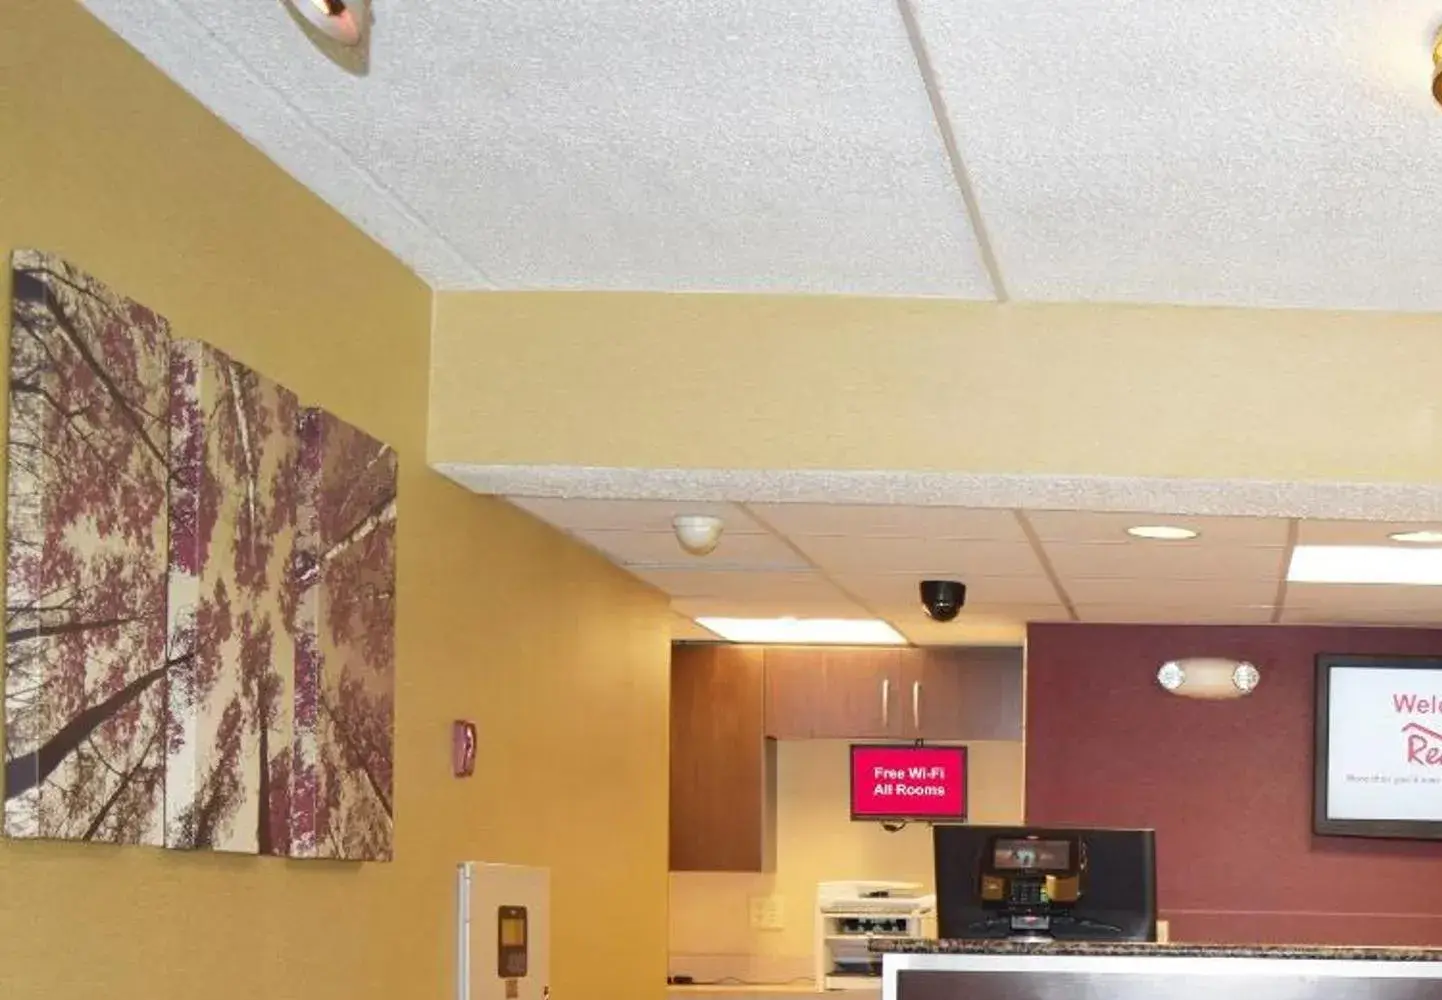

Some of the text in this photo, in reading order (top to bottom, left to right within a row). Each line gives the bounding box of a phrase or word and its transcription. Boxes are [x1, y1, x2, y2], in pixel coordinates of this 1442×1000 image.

[873, 766, 945, 779] Free Wi-Fi
[873, 783, 945, 796] All Rooms
